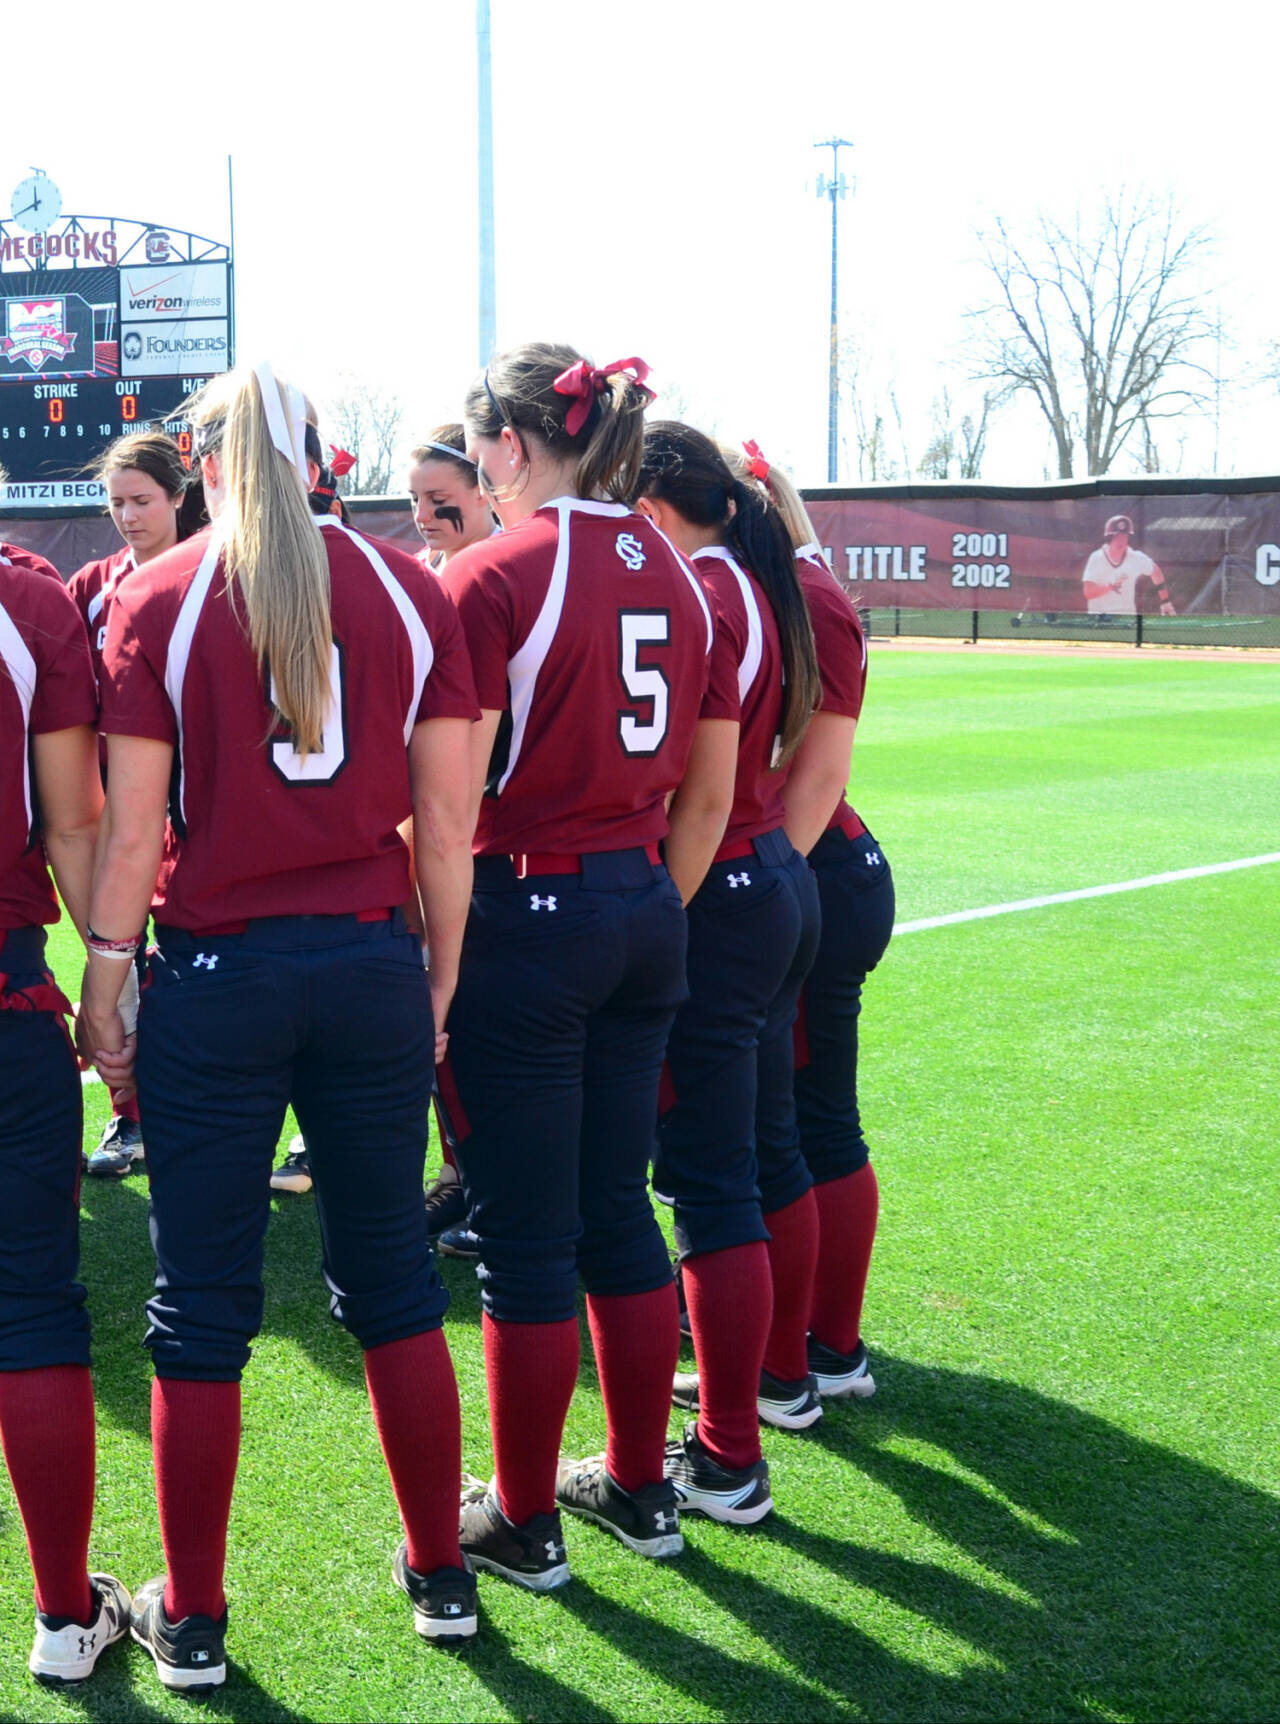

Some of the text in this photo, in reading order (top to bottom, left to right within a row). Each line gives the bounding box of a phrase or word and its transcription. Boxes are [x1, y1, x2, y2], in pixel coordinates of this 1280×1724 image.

[129, 295, 182, 312] verizon
[34, 384, 78, 399] STRIKE
[115, 381, 142, 396] OUT
[49, 395, 136, 422] 0 0
[2, 427, 9, 439] 5
[19, 427, 26, 438] 6
[43, 426, 50, 438] 7
[60, 426, 67, 437] 8
[77, 425, 84, 436] 9
[99, 424, 111, 435] 10
[122, 423, 151, 435] RUNS
[165, 422, 188, 433] HITS
[7, 485, 55, 499] MITZI
[951, 532, 1008, 557] 2001
[845, 546, 926, 581] TITLE
[951, 564, 1010, 587] 2002
[618, 608, 672, 757] 5
